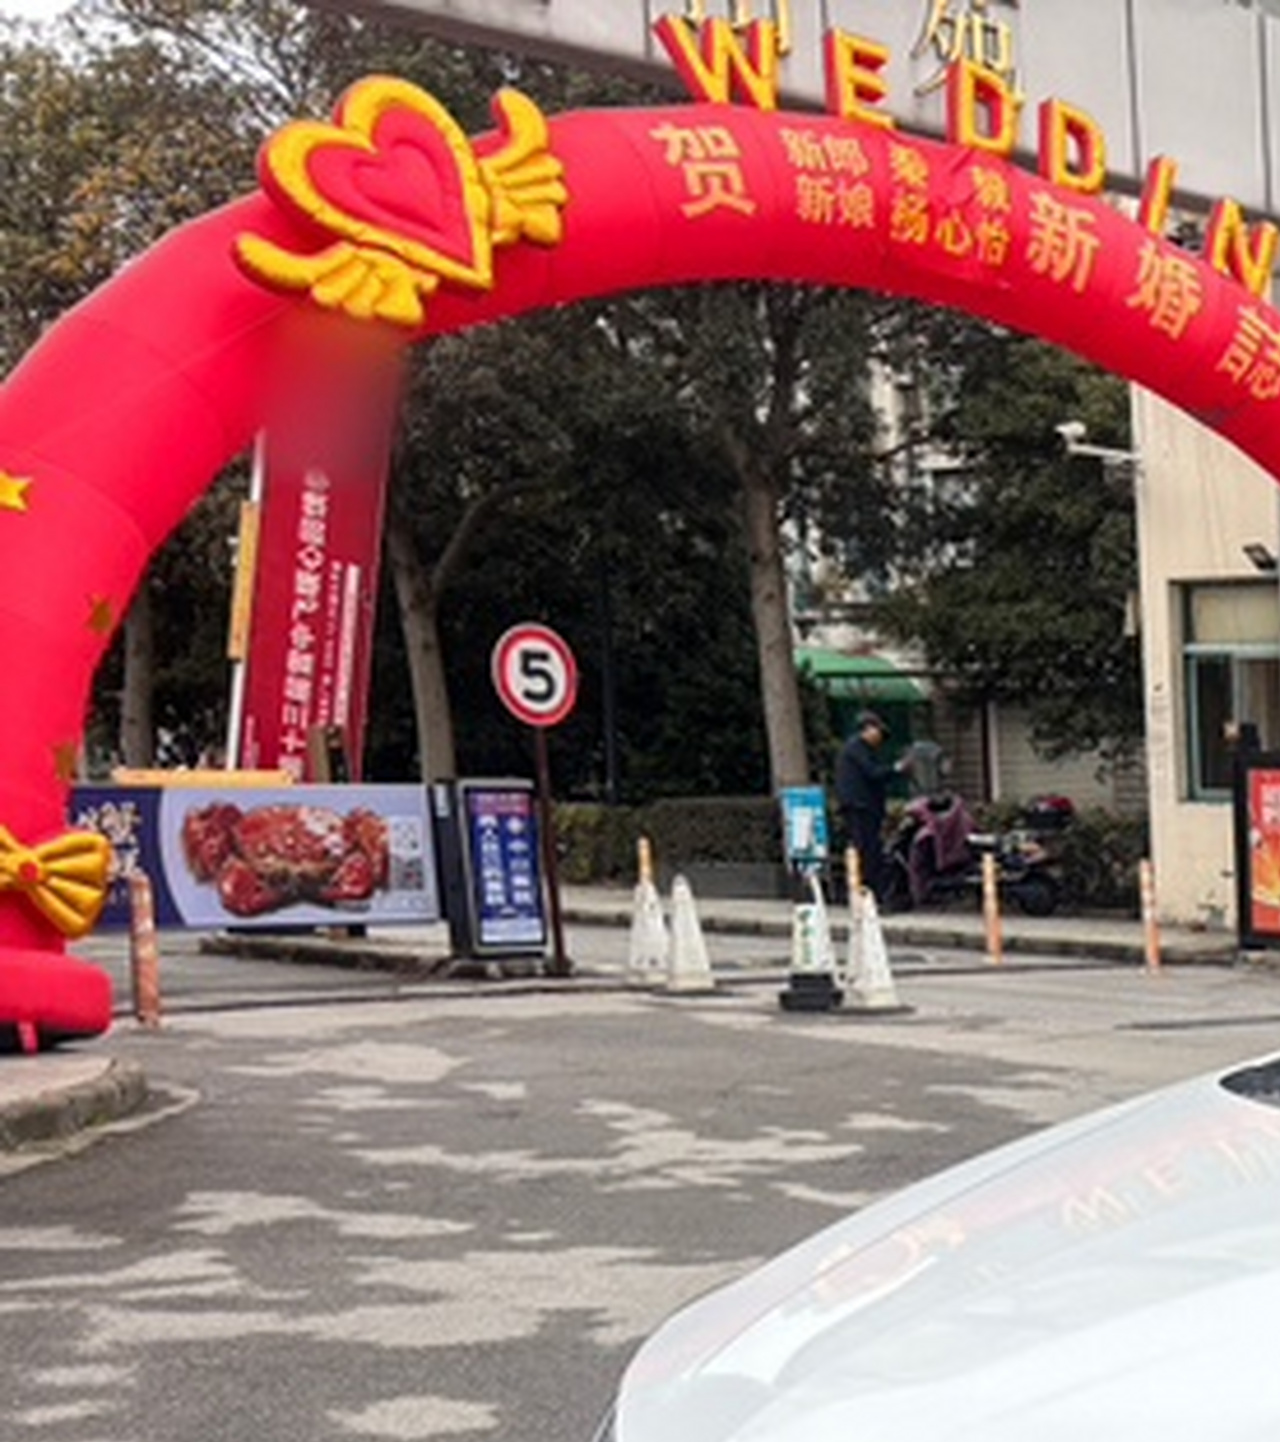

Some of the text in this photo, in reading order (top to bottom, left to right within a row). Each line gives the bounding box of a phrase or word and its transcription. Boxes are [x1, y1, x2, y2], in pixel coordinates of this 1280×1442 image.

[649, 122, 757, 219] 贺
[778, 127, 871, 178] 新郎
[796, 173, 876, 229] 新娘
[519, 648, 557, 704] 5
